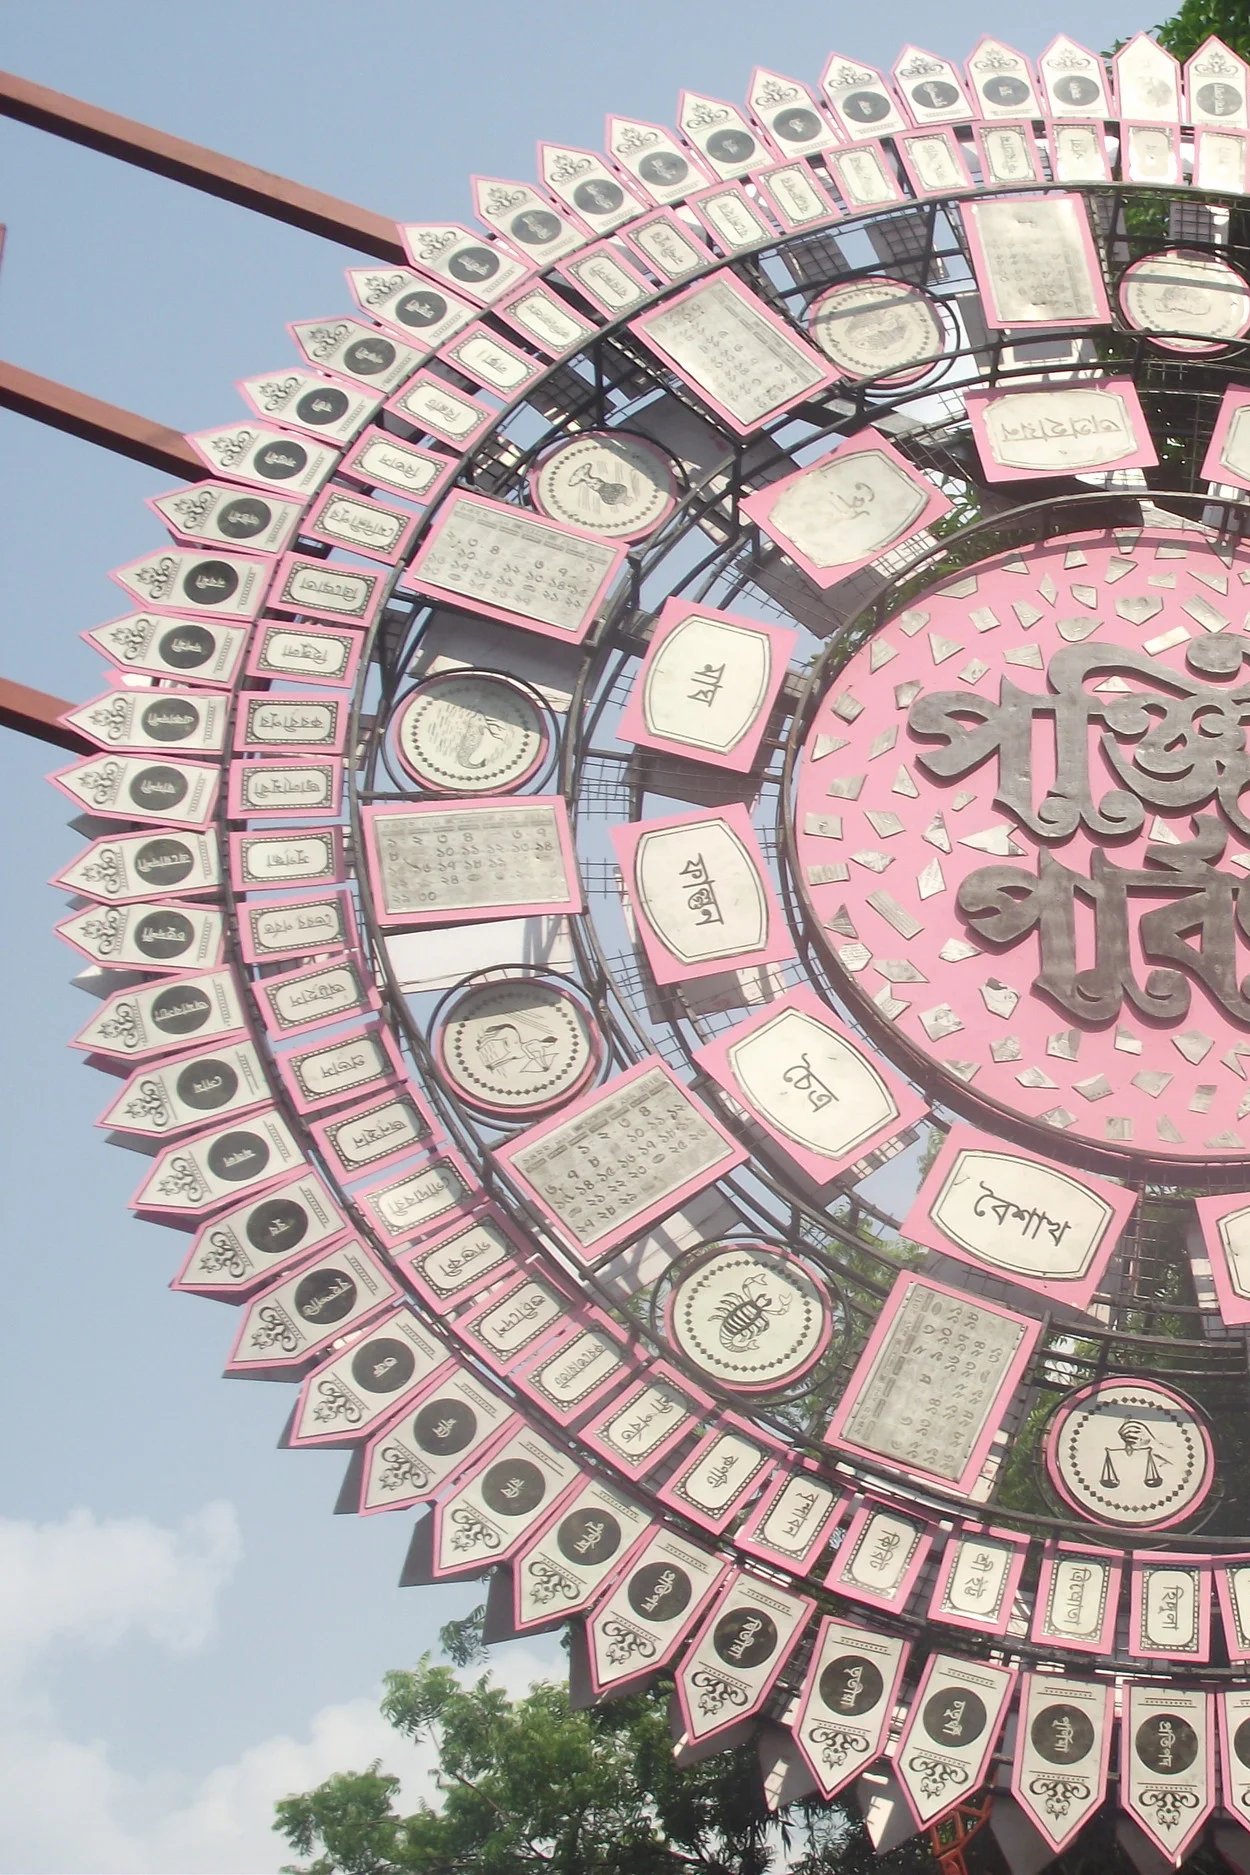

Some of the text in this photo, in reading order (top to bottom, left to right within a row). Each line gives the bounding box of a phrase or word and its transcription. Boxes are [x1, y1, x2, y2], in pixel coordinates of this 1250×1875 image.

[686, 663, 725, 707] মাঘ
[259, 712, 324, 732] করবীপুর
[253, 777, 320, 798] জ্বালামুখী
[266, 849, 309, 867] সুগন্ধা
[678, 852, 724, 925] ফাল্গুন
[155, 1000, 208, 1021] অমাবস্যা
[289, 983, 346, 1007] অট্টহাস
[193, 1076, 221, 1092] সোম
[320, 1054, 364, 1078] প্রভাস
[782, 1052, 839, 1112] চৈত্র
[387, 1176, 449, 1216] গোদাবরী
[973, 1180, 1071, 1246] বৈশাখ
[268, 1219, 289, 1235] বুধ
[302, 1278, 352, 1314] বৃহস্পতি
[491, 1295, 545, 1337] শুচীদেশ
[432, 1418, 456, 1437] শনি
[621, 1396, 673, 1443] শ্রী পর্বত
[500, 1477, 524, 1497] রবি
[706, 1455, 738, 1488] কর্ণাট
[782, 1492, 819, 1537] বৃন্দাবন
[573, 1521, 603, 1553] পূর্ণিমা
[869, 1530, 900, 1570] কিরিট
[641, 1570, 675, 1611] প্রতিপদ
[728, 1616, 761, 1658] দ্বিতীয়া
[840, 1666, 862, 1707] তৃতীয়া
[942, 1701, 965, 1735] চতুর্থী
[1052, 1716, 1073, 1752] পূর্ণিমা
[1158, 1721, 1175, 1766] প্রতিপদ
